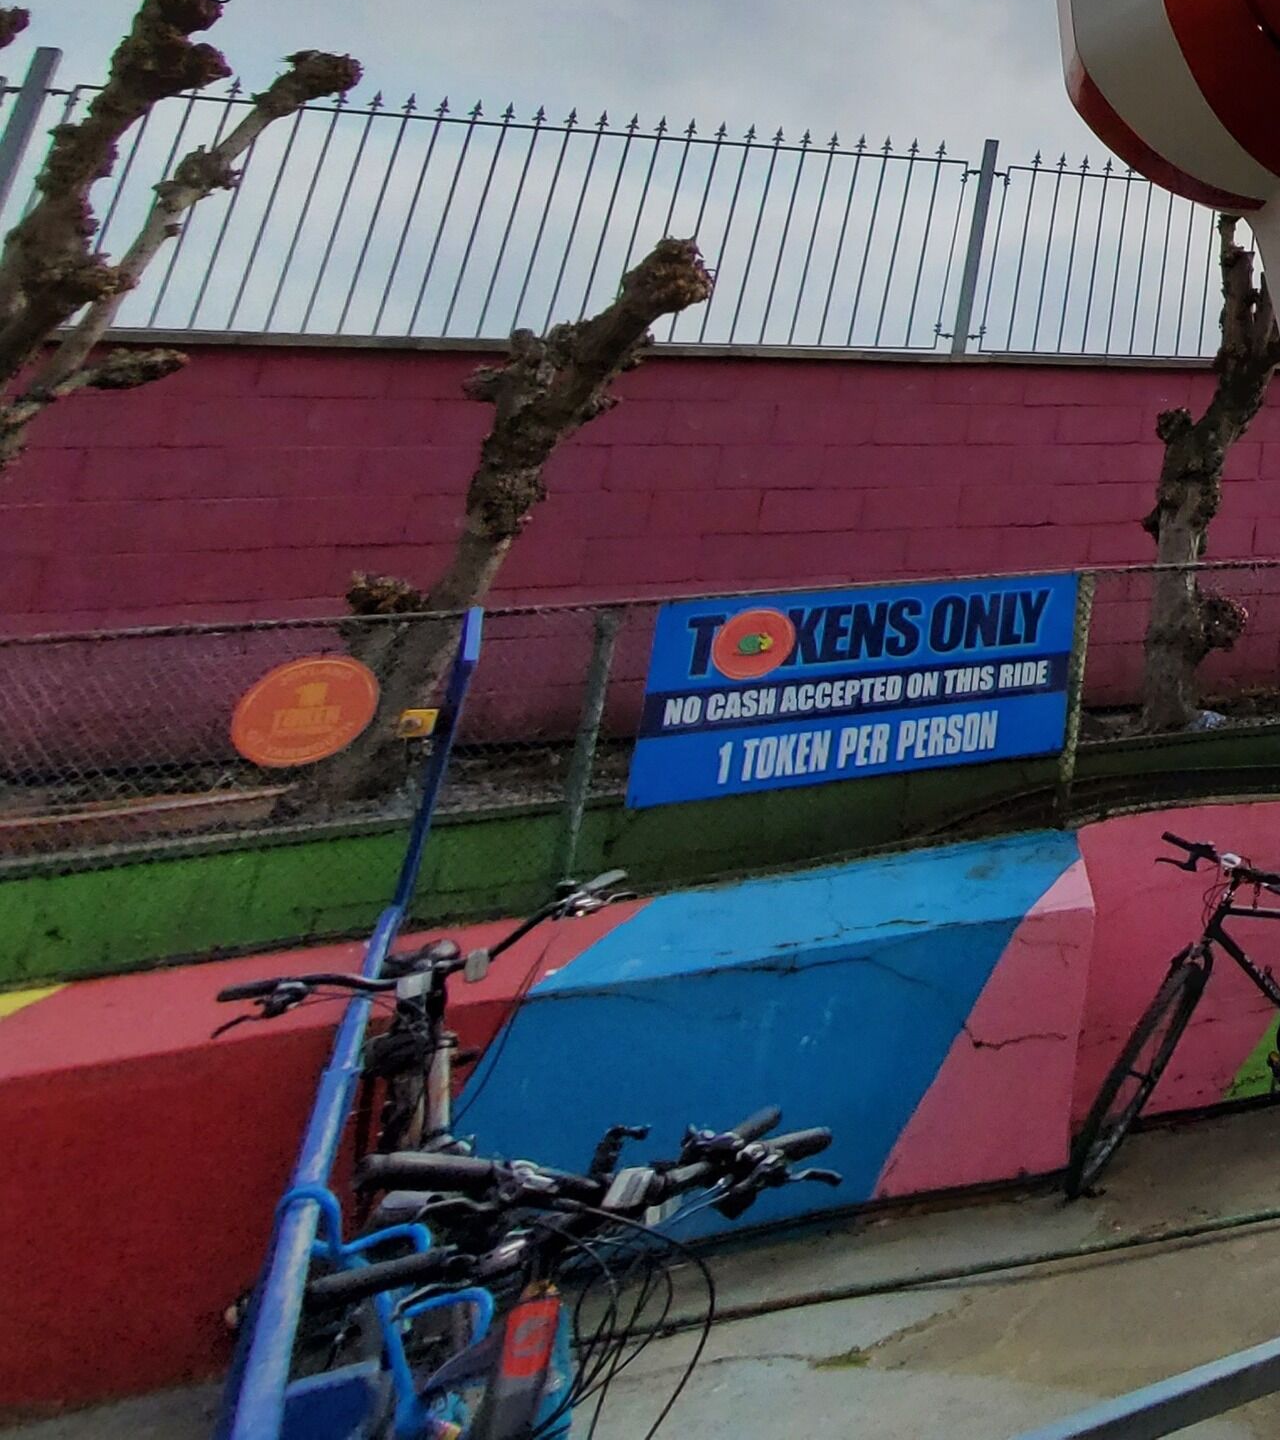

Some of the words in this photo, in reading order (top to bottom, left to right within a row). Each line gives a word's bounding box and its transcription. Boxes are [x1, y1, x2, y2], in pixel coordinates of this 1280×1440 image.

[929, 589, 1051, 653] ONLY
[662, 698, 701, 728] NO
[706, 687, 776, 722] CASH
[780, 677, 901, 713] ACCEPTED
[907, 671, 936, 699] ON
[944, 665, 994, 693] THIS
[998, 659, 1049, 688] RIDE
[716, 741, 732, 785] 1
[740, 729, 831, 783] TOKEN
[837, 723, 891, 769] PER
[896, 710, 999, 761] PERSON
